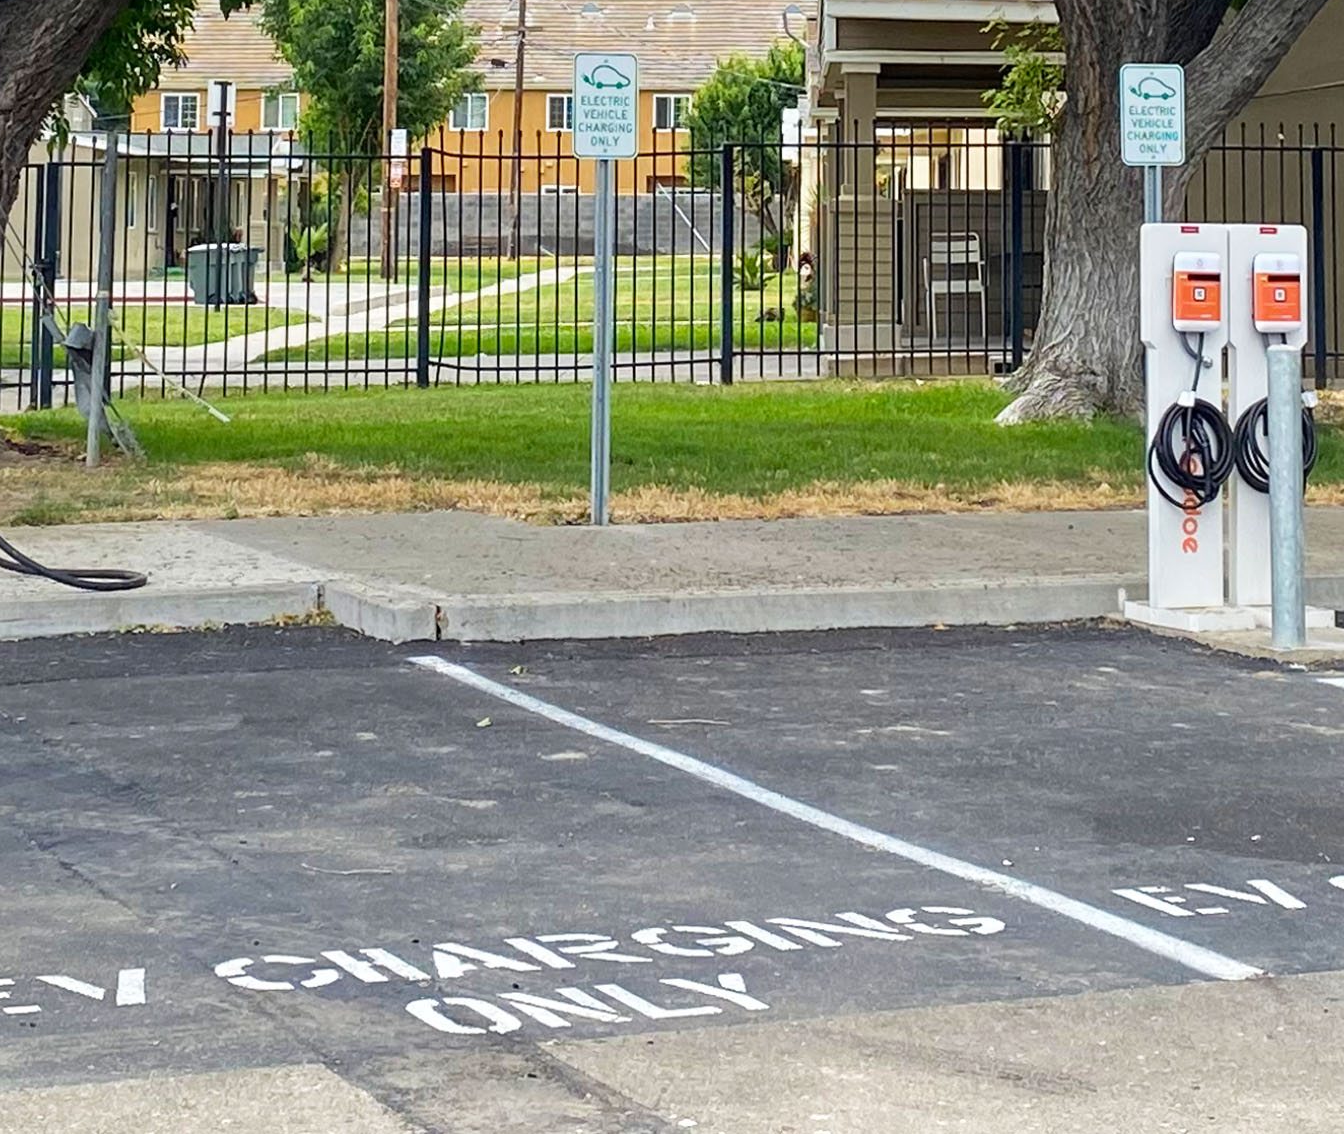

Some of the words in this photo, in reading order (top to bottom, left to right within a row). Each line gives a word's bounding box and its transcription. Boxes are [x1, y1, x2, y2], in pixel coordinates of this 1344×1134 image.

[580, 95, 630, 107] ELECTRIC
[583, 109, 628, 120] VEHICLE
[1128, 105, 1176, 116] ELECTRIC
[578, 122, 633, 134] CHARGING
[1131, 118, 1174, 129] VEHICLE
[590, 136, 620, 147] ONLY
[1126, 131, 1179, 141] CHARGING
[1139, 143, 1167, 154] ONLY
[1111, 878, 1307, 917] EV
[214, 904, 1006, 992] CHARGING
[404, 971, 770, 1036] ONLY
